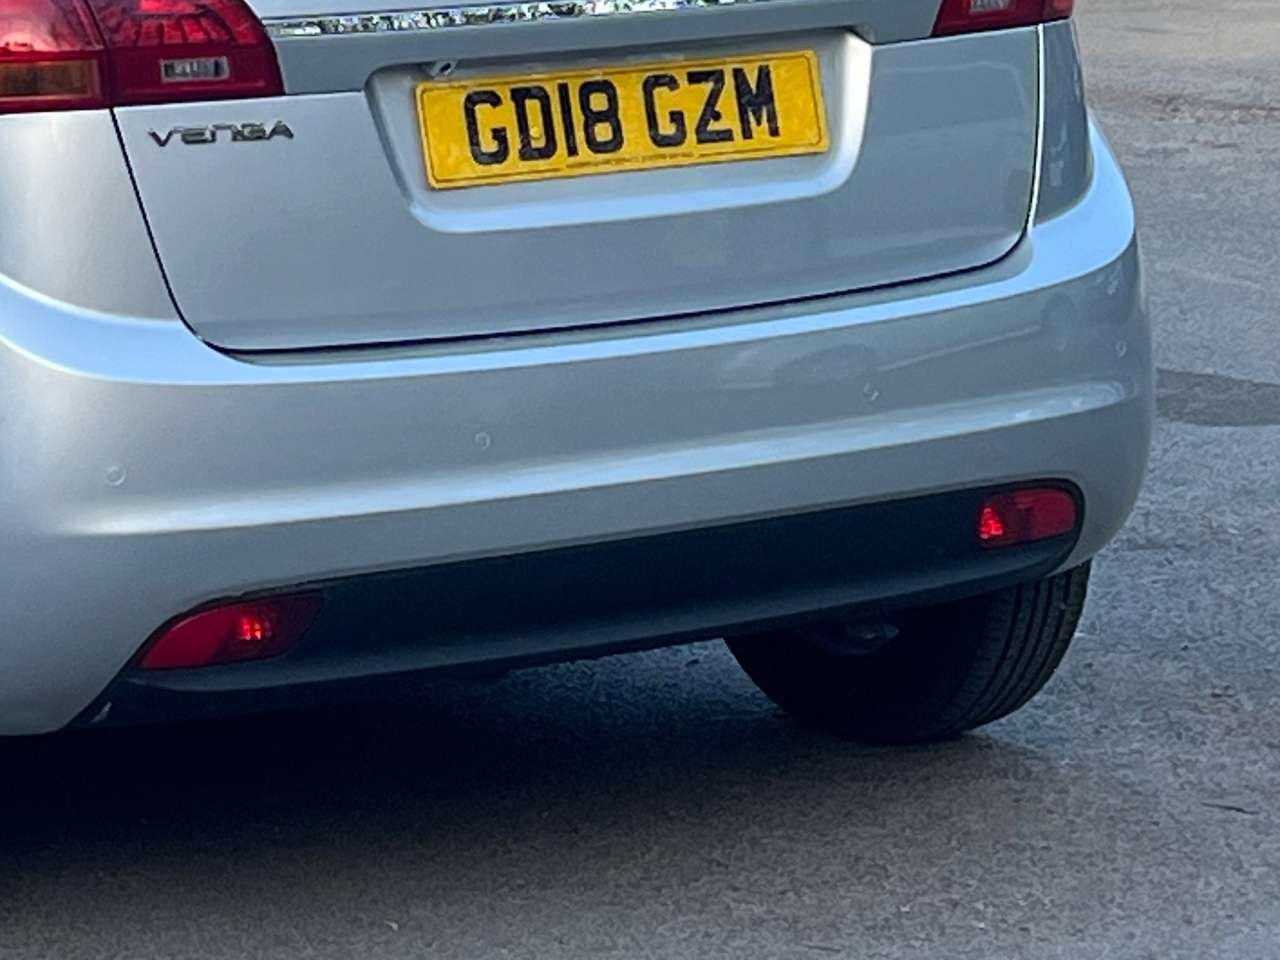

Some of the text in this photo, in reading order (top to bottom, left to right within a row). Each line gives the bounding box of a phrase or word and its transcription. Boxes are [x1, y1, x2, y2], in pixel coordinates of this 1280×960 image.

[147, 120, 294, 148] VENGA
[463, 64, 781, 166] GD18 GZM
